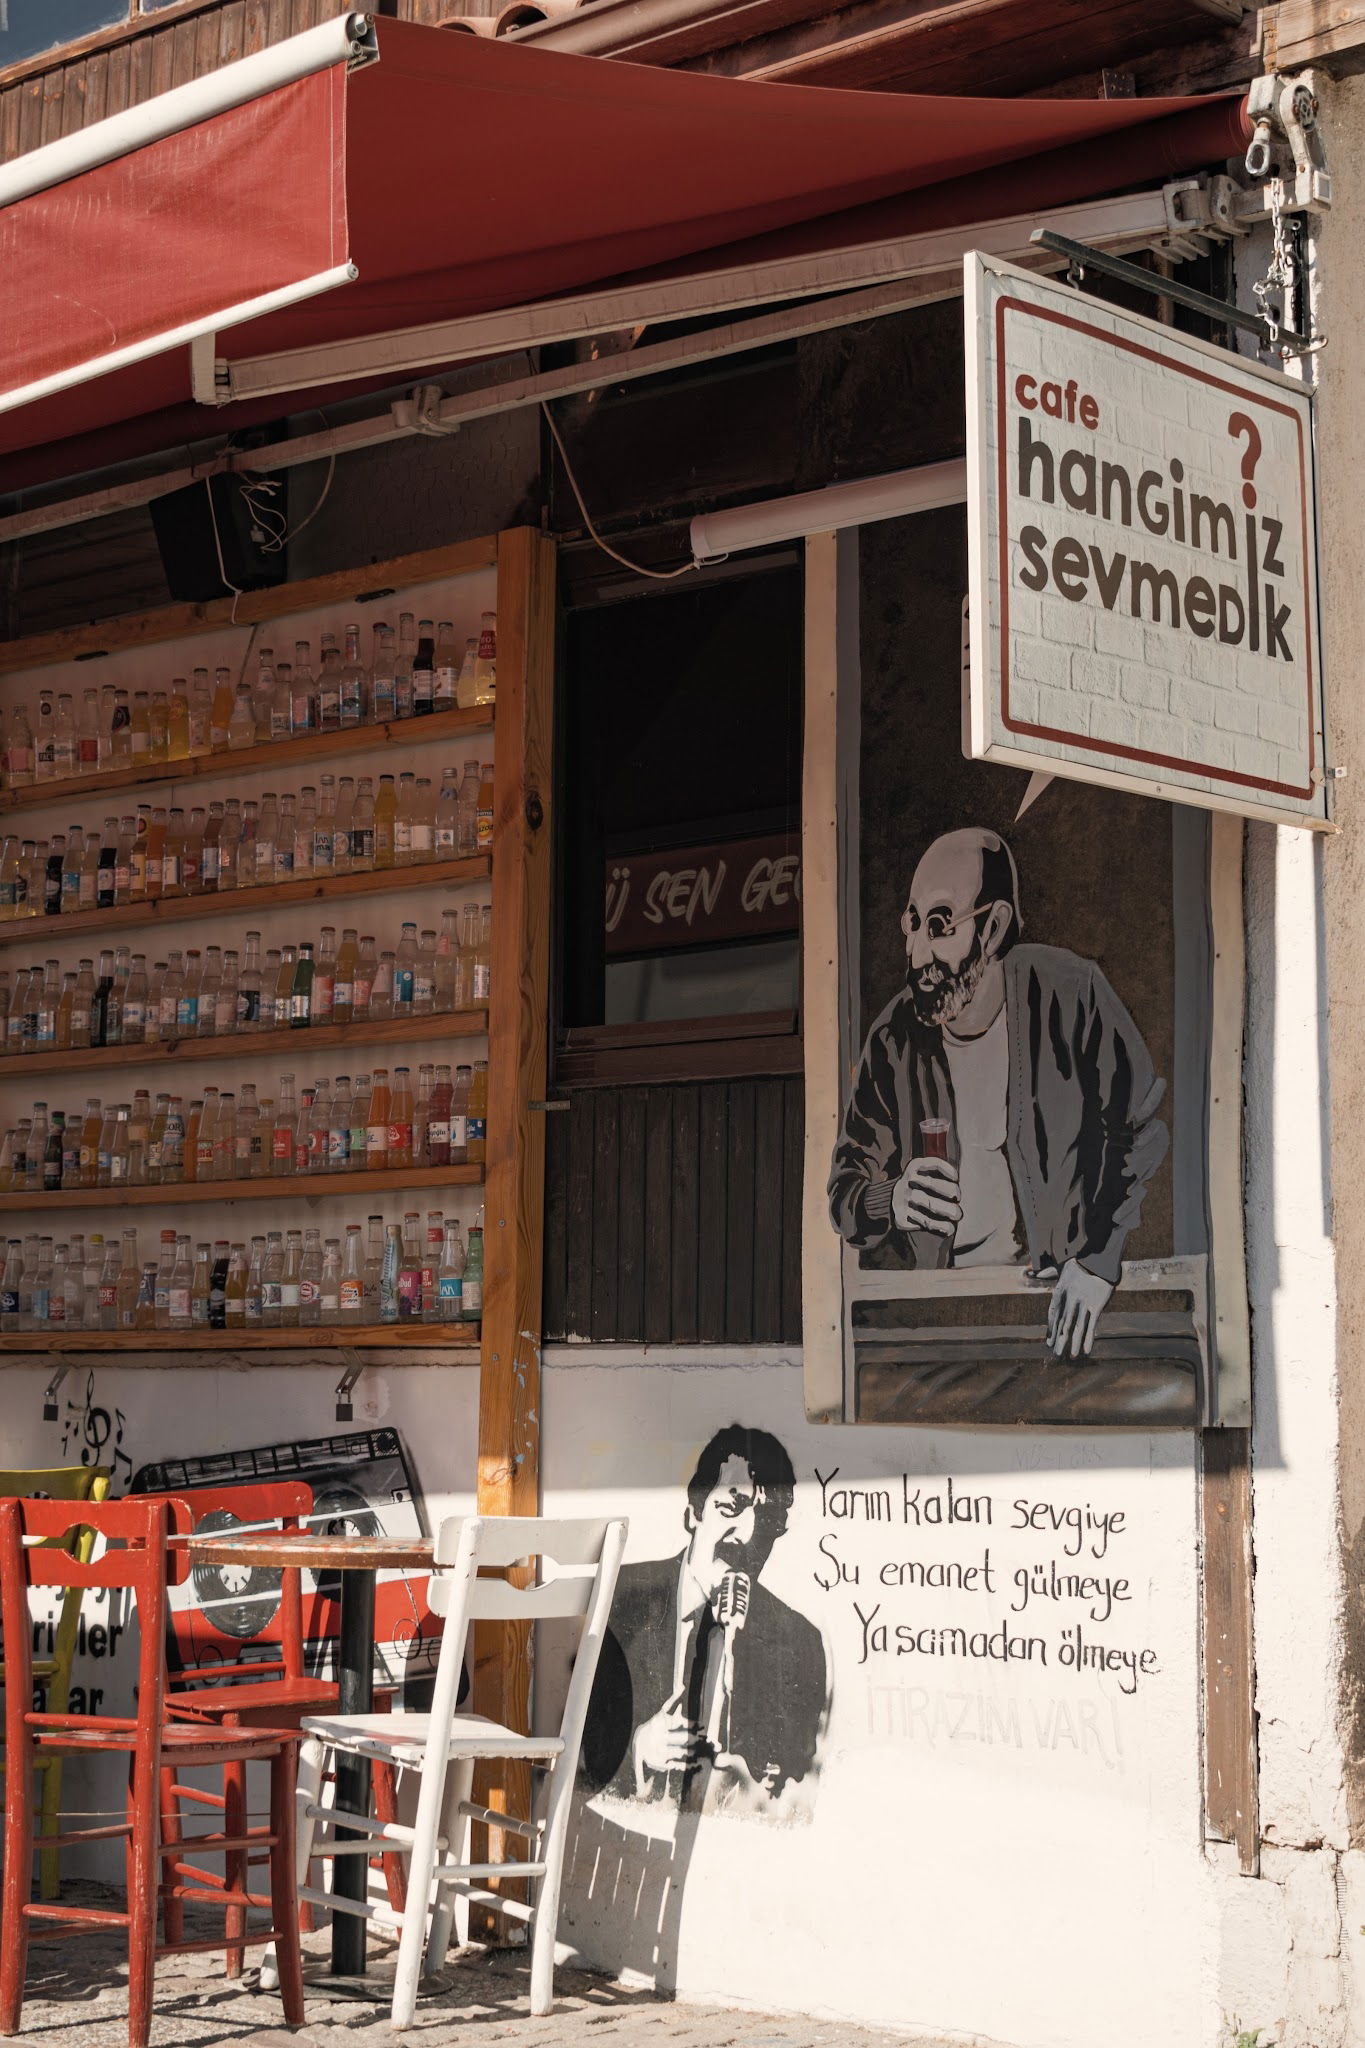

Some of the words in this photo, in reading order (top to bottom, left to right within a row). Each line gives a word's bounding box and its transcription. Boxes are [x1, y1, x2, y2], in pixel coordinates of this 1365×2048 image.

[1015, 373, 1099, 431] cafe
[642, 859, 727, 926] SEN
[902, 1472, 993, 1526] kalan
[1010, 1499, 1127, 1559] sevgiye
[879, 1547, 997, 1594] emanet
[1010, 1560, 1133, 1622] gülmeye
[1058, 1623, 1164, 1695] ölmeye
